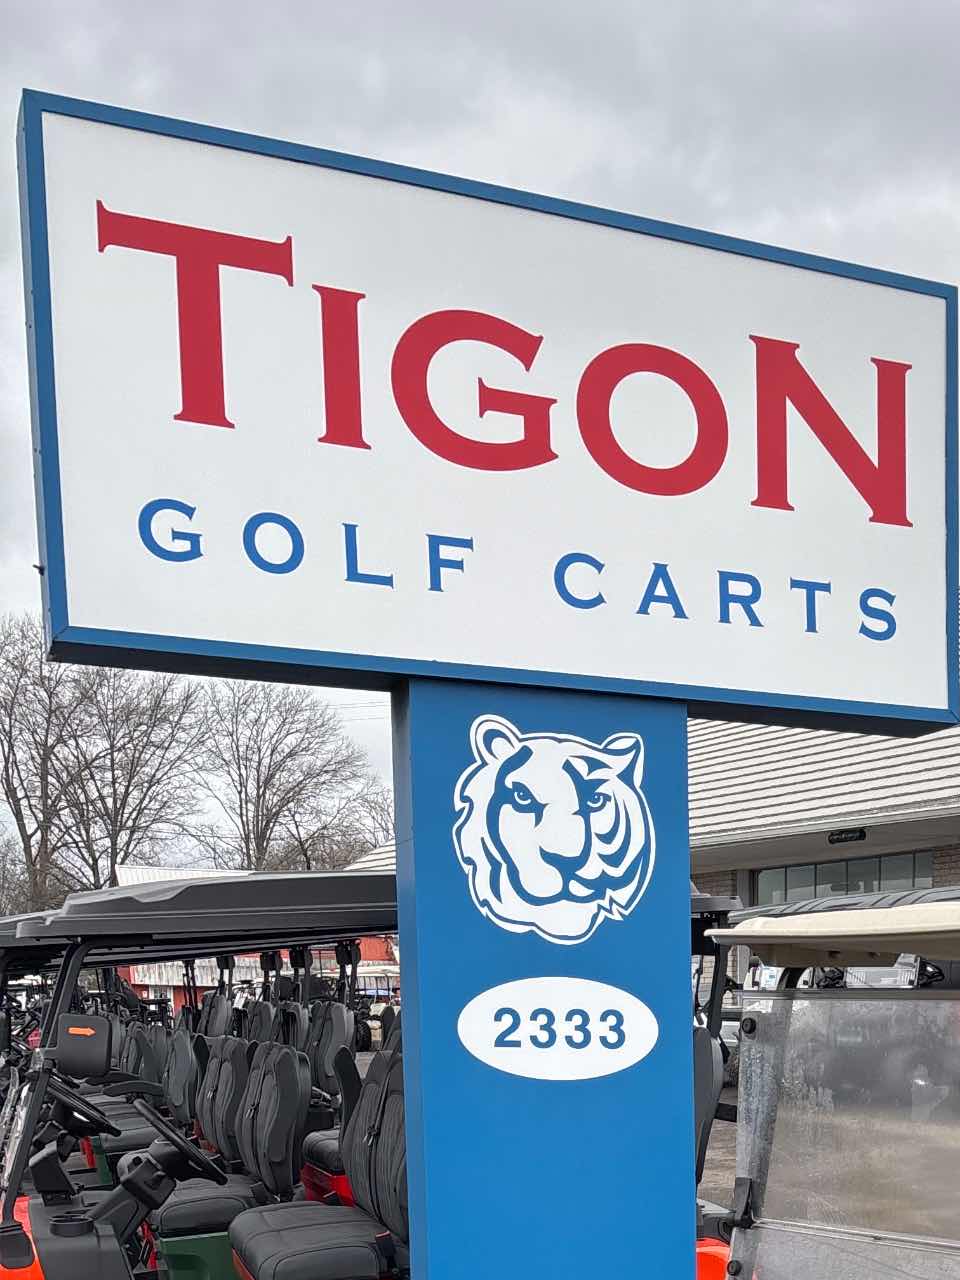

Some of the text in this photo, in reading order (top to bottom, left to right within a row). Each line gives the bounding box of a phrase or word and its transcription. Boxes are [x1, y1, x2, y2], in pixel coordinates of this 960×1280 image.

[96, 200, 914, 528] TIGON
[137, 497, 898, 642] GOLF CARTS
[493, 1007, 626, 1050] 2333
